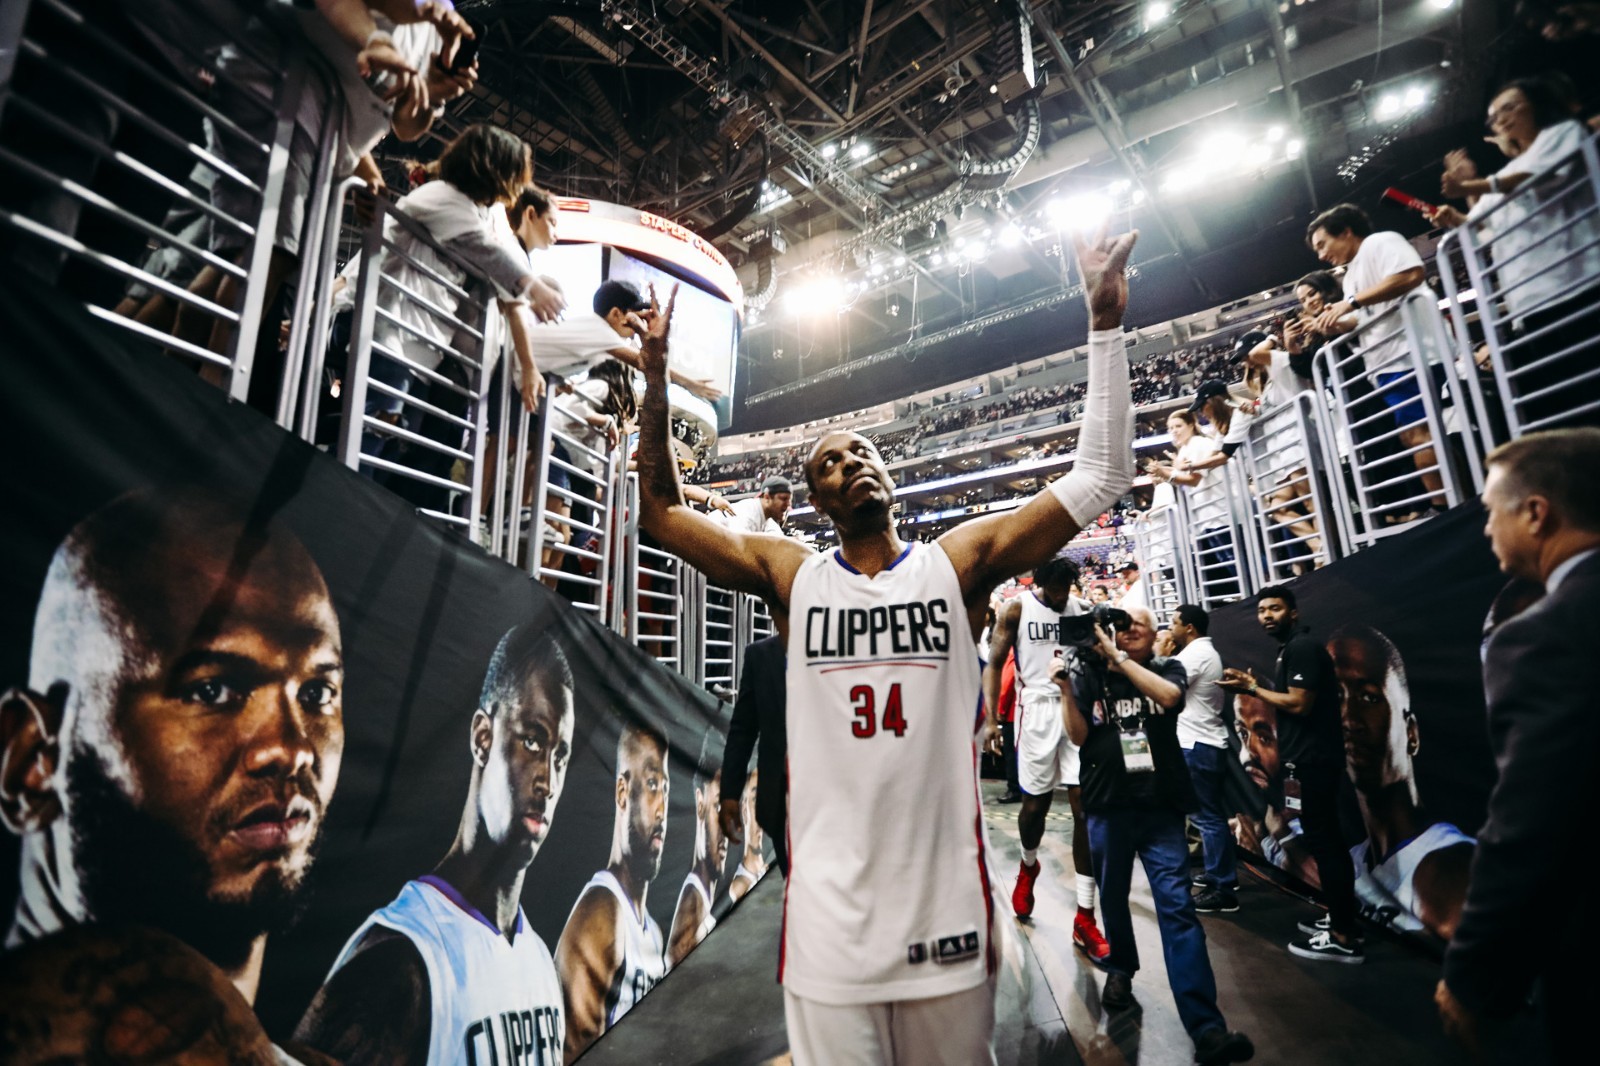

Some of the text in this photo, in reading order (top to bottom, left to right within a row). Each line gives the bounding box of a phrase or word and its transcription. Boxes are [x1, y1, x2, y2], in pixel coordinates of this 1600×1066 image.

[640, 211, 690, 243] STAPLES
[805, 598, 950, 658] CLIPPERS
[1027, 621, 1061, 641] CLIPP
[849, 683, 908, 739] 34
[1114, 697, 1142, 718] NBA
